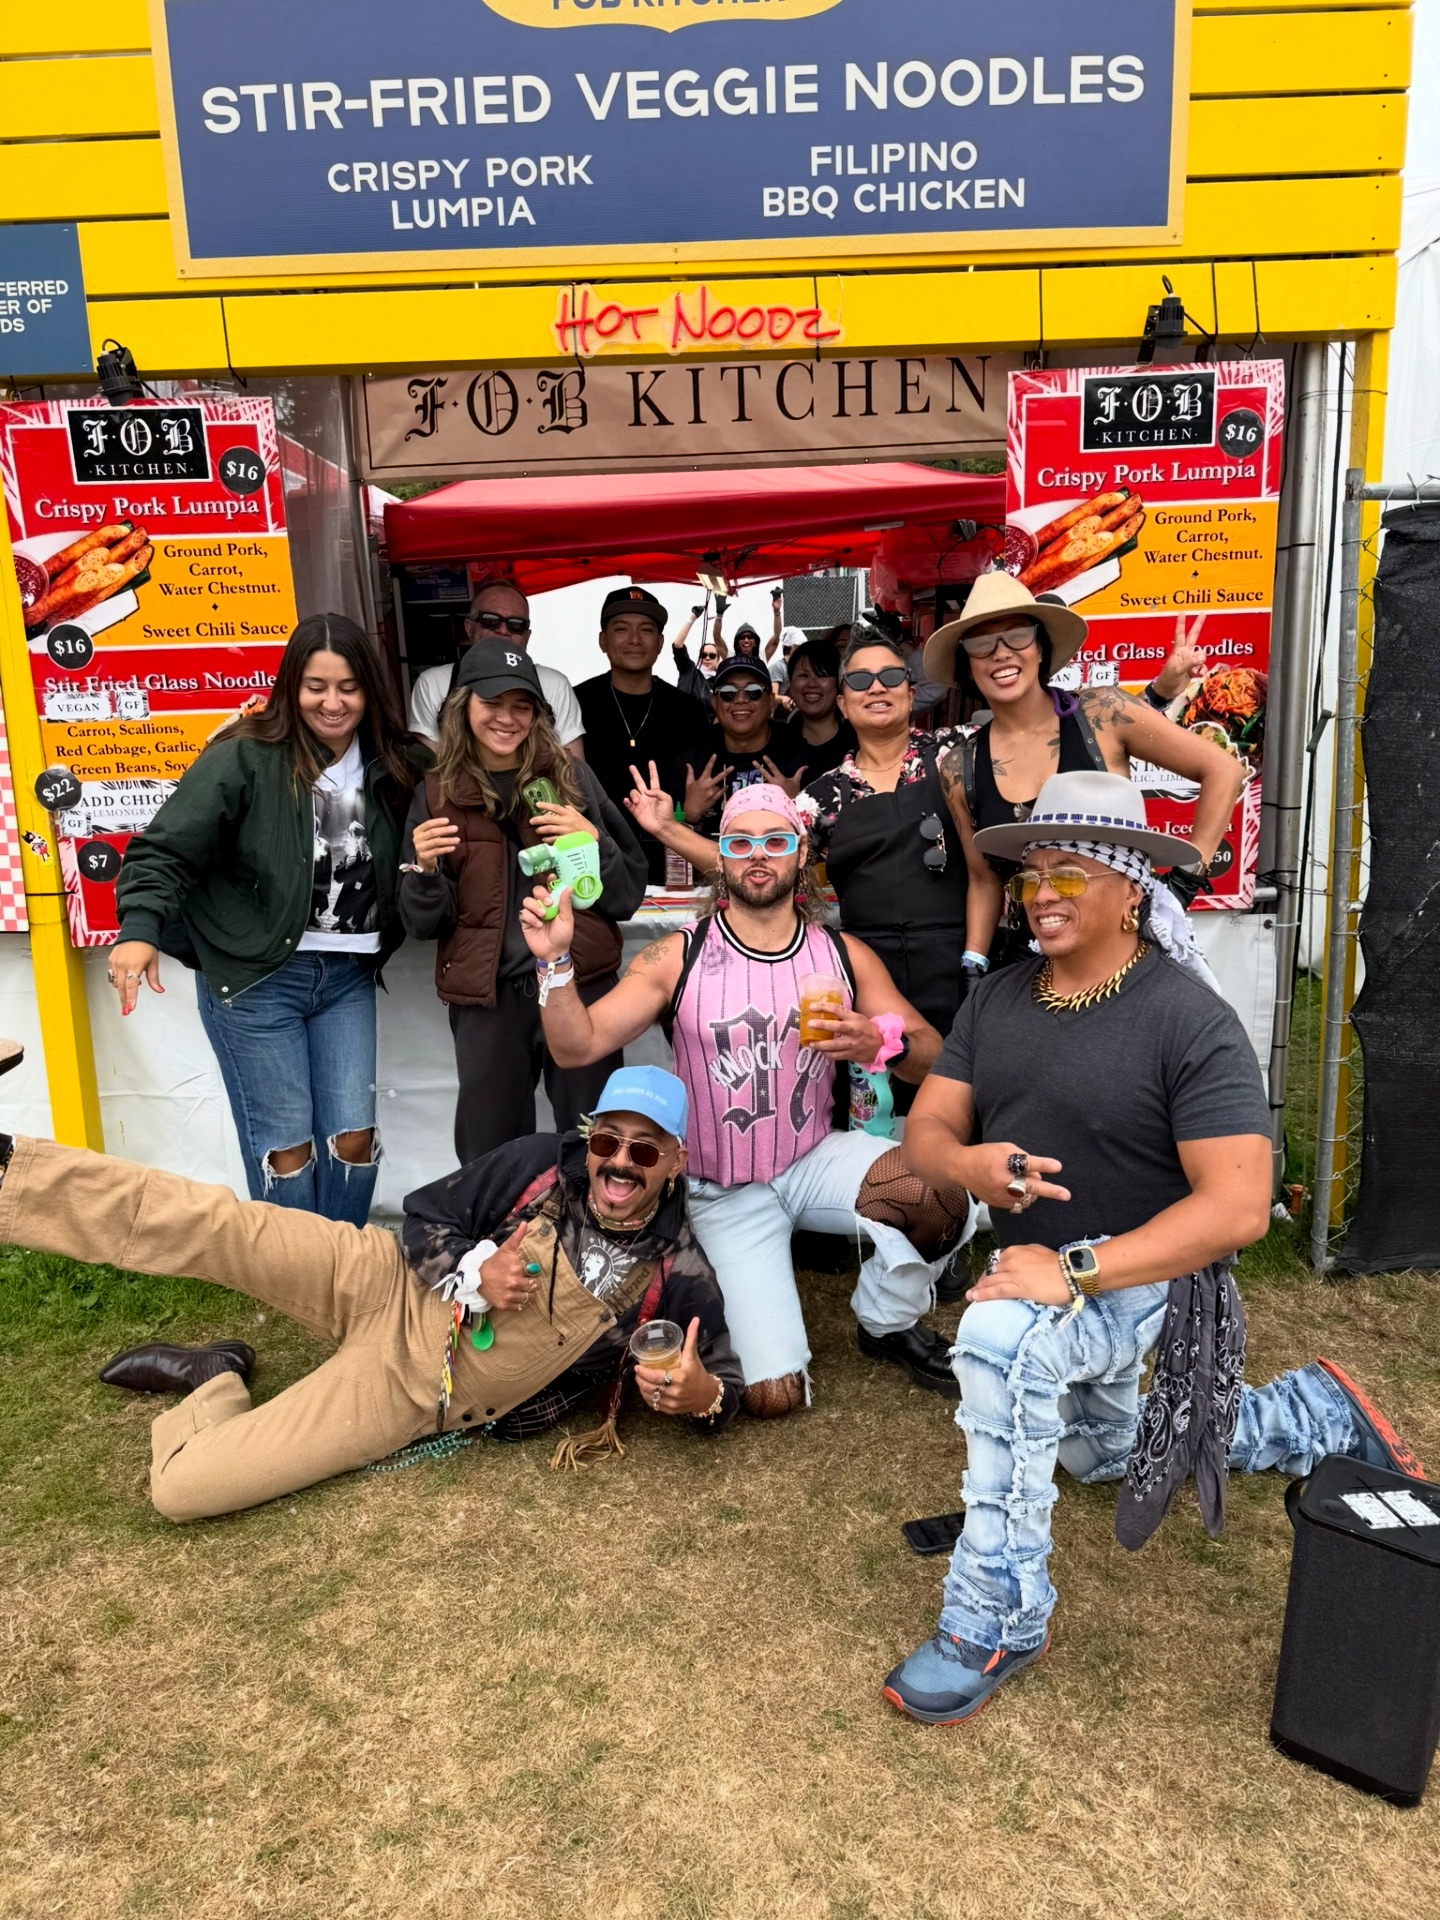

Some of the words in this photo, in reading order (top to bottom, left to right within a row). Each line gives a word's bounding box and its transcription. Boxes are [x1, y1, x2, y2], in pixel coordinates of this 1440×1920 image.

[201, 75, 551, 134] STIR-FRIED
[575, 64, 819, 121] VEGGIE
[845, 54, 1145, 111] NOODLES
[810, 140, 978, 176] FILIPINO
[328, 159, 470, 193] CRISPY
[486, 155, 594, 188] PORK
[763, 185, 838, 219] BBQ
[854, 178, 1025, 213] CHICKEN
[391, 196, 536, 230] LUMPIA
[27, 298, 53, 314] OF
[627, 355, 992, 428] KITCHEN
[1225, 424, 1258, 443] $16
[226, 460, 258, 481] $16
[1037, 467, 1106, 492] Crispy
[1113, 464, 1165, 485] Pork
[1170, 459, 1257, 486] Lumpia
[35, 498, 107, 524] Crispy
[114, 497, 167, 517] Pork
[173, 494, 260, 521] Lumpia
[1154, 510, 1213, 526] Ground
[1217, 508, 1257, 524] Pork,
[1176, 529, 1229, 544] Carrot,
[163, 544, 223, 560] Ground
[227, 542, 268, 558] Pork,
[1144, 550, 1188, 564] Water
[1191, 548, 1263, 563] Chestnut.
[189, 563, 243, 578] Carrot,
[159, 582, 203, 597] Water
[207, 581, 281, 596] Chestnut.
[1120, 592, 1167, 607] Sweet
[1172, 590, 1211, 605] Chili
[1216, 590, 1264, 603] Sauce
[142, 624, 190, 640] Sweet
[195, 622, 235, 637] Chili
[240, 623, 289, 637] Sauce
[54, 639, 86, 657] $16
[1070, 644, 1106, 662] ied
[1112, 643, 1165, 661] Glass
[1193, 638, 1254, 656] oodles
[45, 677, 81, 694] Stir
[85, 675, 138, 693] Fried
[144, 674, 198, 691] Glass
[1095, 671, 1111, 681] GF
[57, 702, 101, 713] VEGAN
[124, 700, 140, 711] GF
[67, 725, 116, 739] Carrot,
[119, 723, 185, 737] Scallions,
[56, 745, 83, 758] Red
[87, 743, 152, 759] Cabbage,
[155, 740, 202, 756] Garlic,
[70, 763, 111, 776] Green
[116, 761, 161, 776] Beans,
[42, 778, 74, 803] $22
[81, 796, 114, 808] ADD
[68, 820, 83, 828] GF
[89, 855, 107, 870] $7
[708, 1040, 784, 1089] KNOCK
